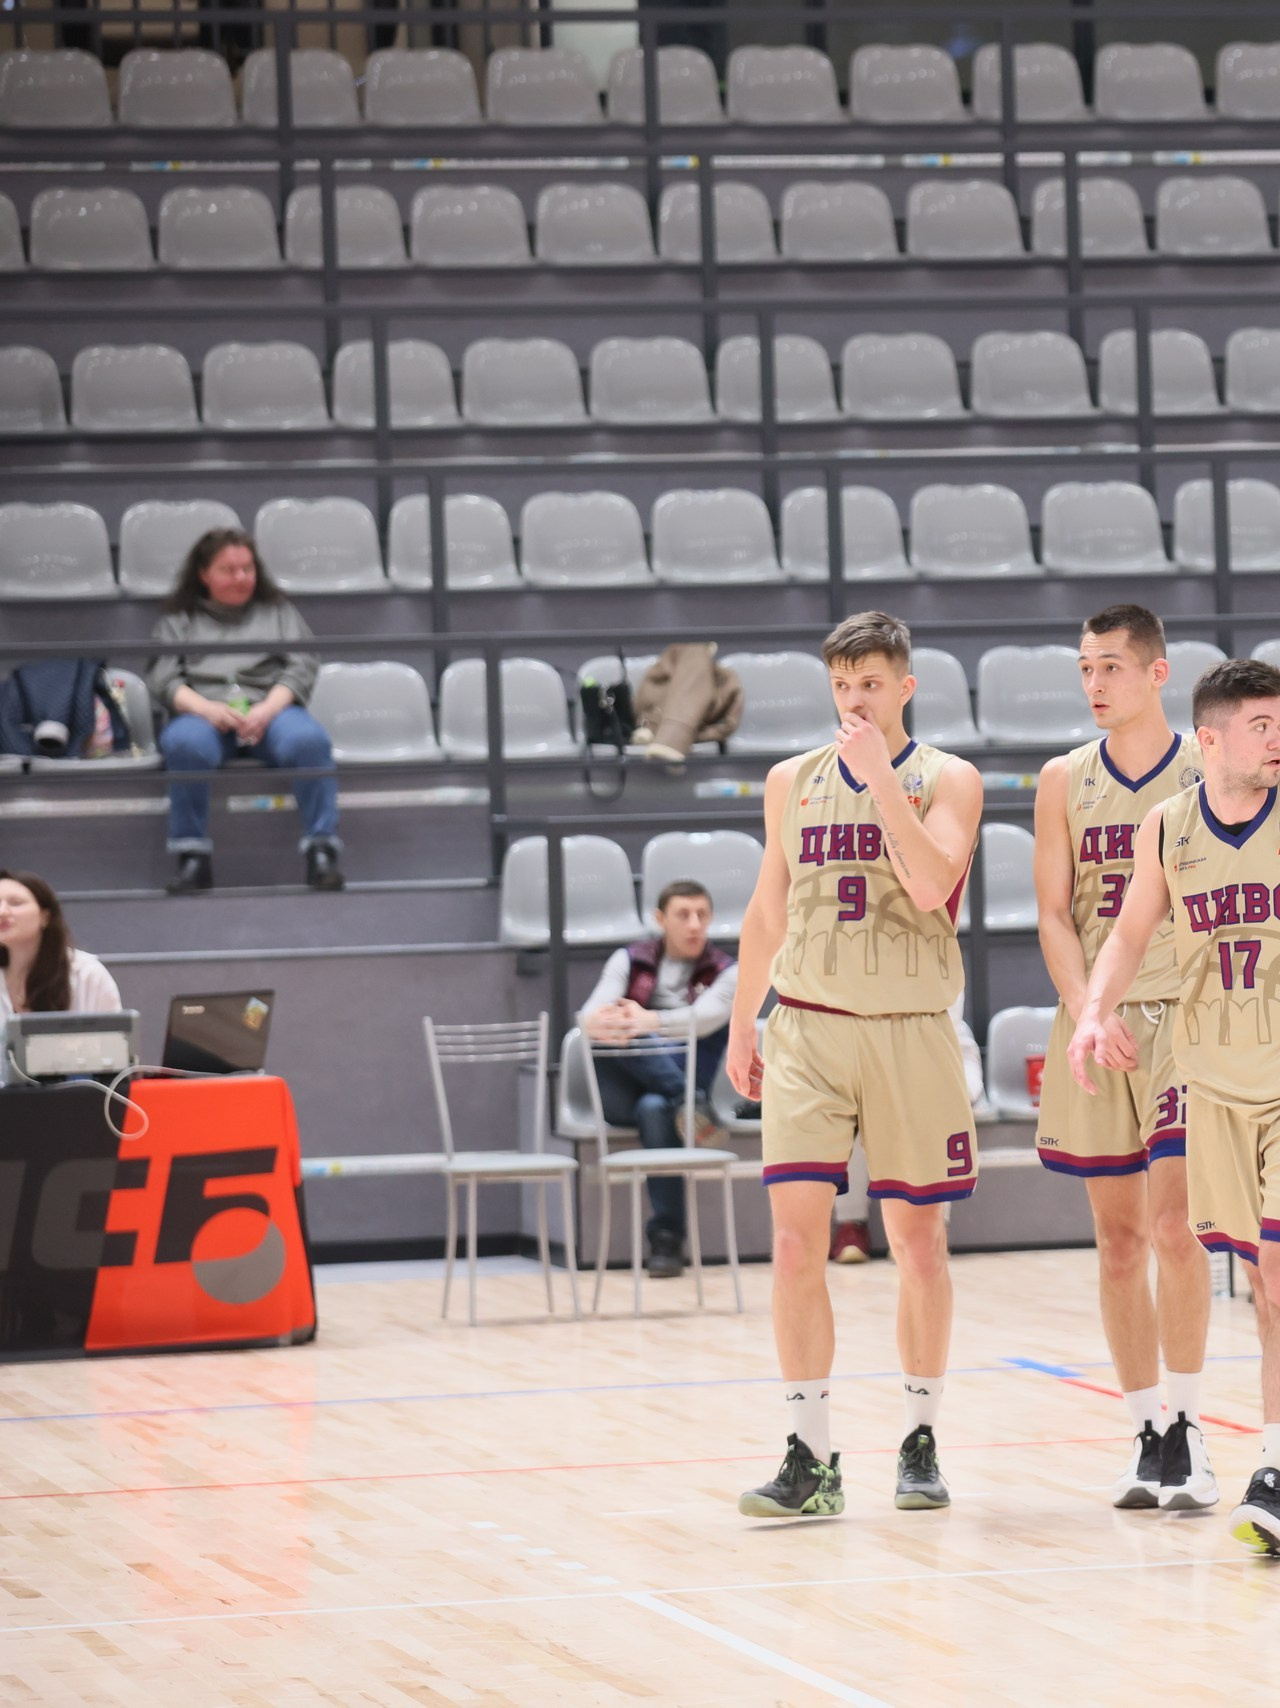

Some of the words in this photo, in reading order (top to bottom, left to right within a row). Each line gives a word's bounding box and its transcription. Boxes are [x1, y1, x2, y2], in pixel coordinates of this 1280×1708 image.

[799, 823, 891, 866] ЦИВ
[838, 876, 867, 921] 9
[1097, 873, 1133, 917] 3
[1218, 940, 1261, 990] 17
[1155, 1086, 1187, 1130] 3
[947, 1131, 973, 1177] 9
[0, 1145, 287, 1305] СБ
